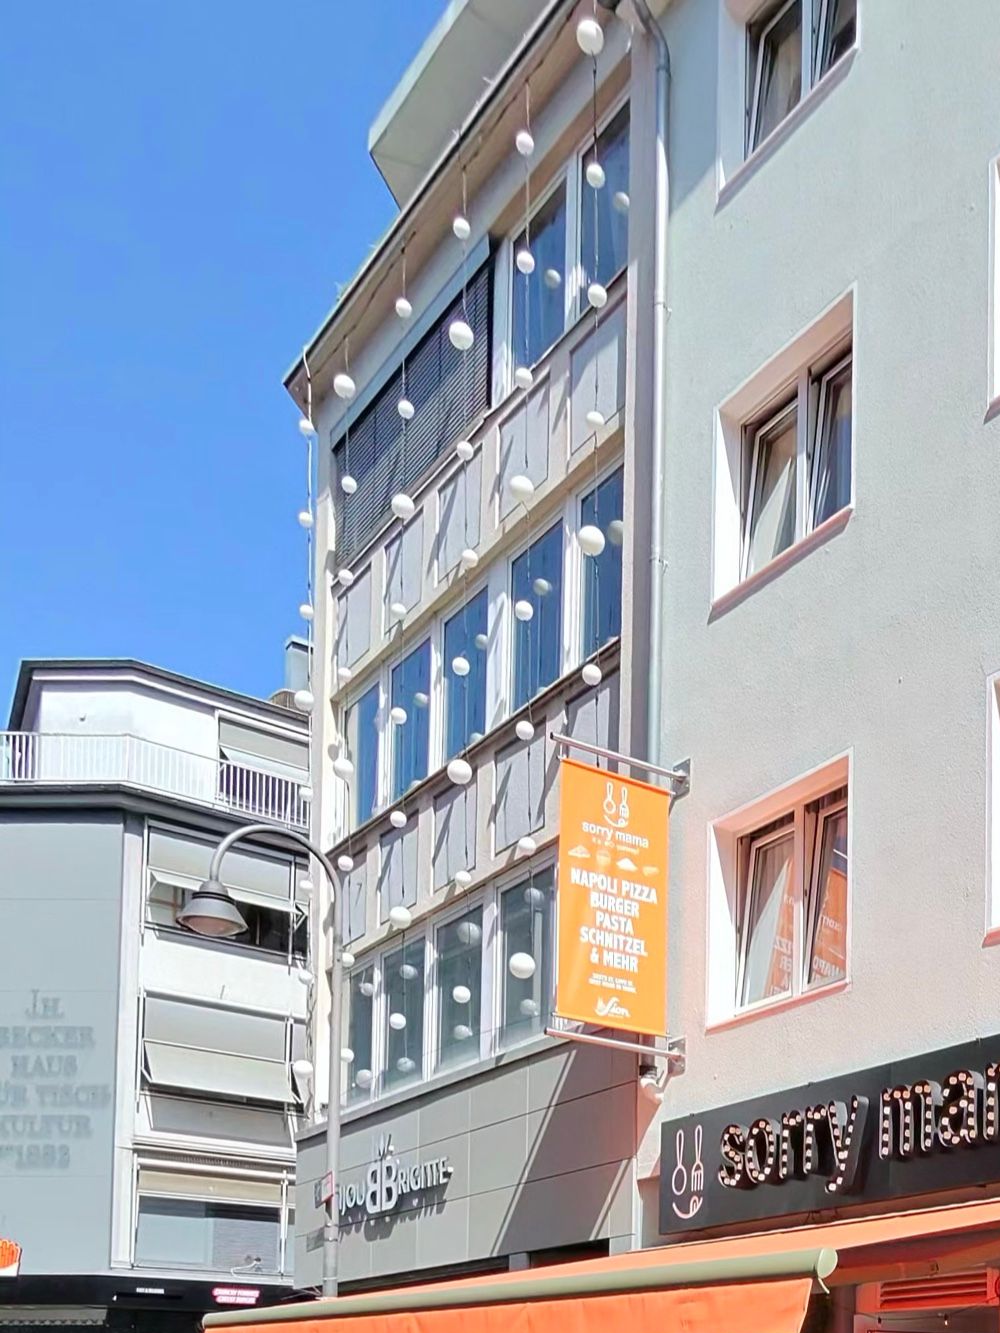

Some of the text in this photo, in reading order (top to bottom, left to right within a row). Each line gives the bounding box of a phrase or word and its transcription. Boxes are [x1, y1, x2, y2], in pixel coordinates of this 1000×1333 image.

[582, 821, 613, 841] sorry
[615, 830, 649, 849] mama
[570, 866, 658, 904] NAPOLI PIZZA
[590, 891, 639, 918] BURGER
[596, 910, 634, 936] PASTA
[580, 924, 648, 957] SCHNITZEL
[590, 946, 638, 973] & MEHR
[718, 1095, 869, 1193] sorry
